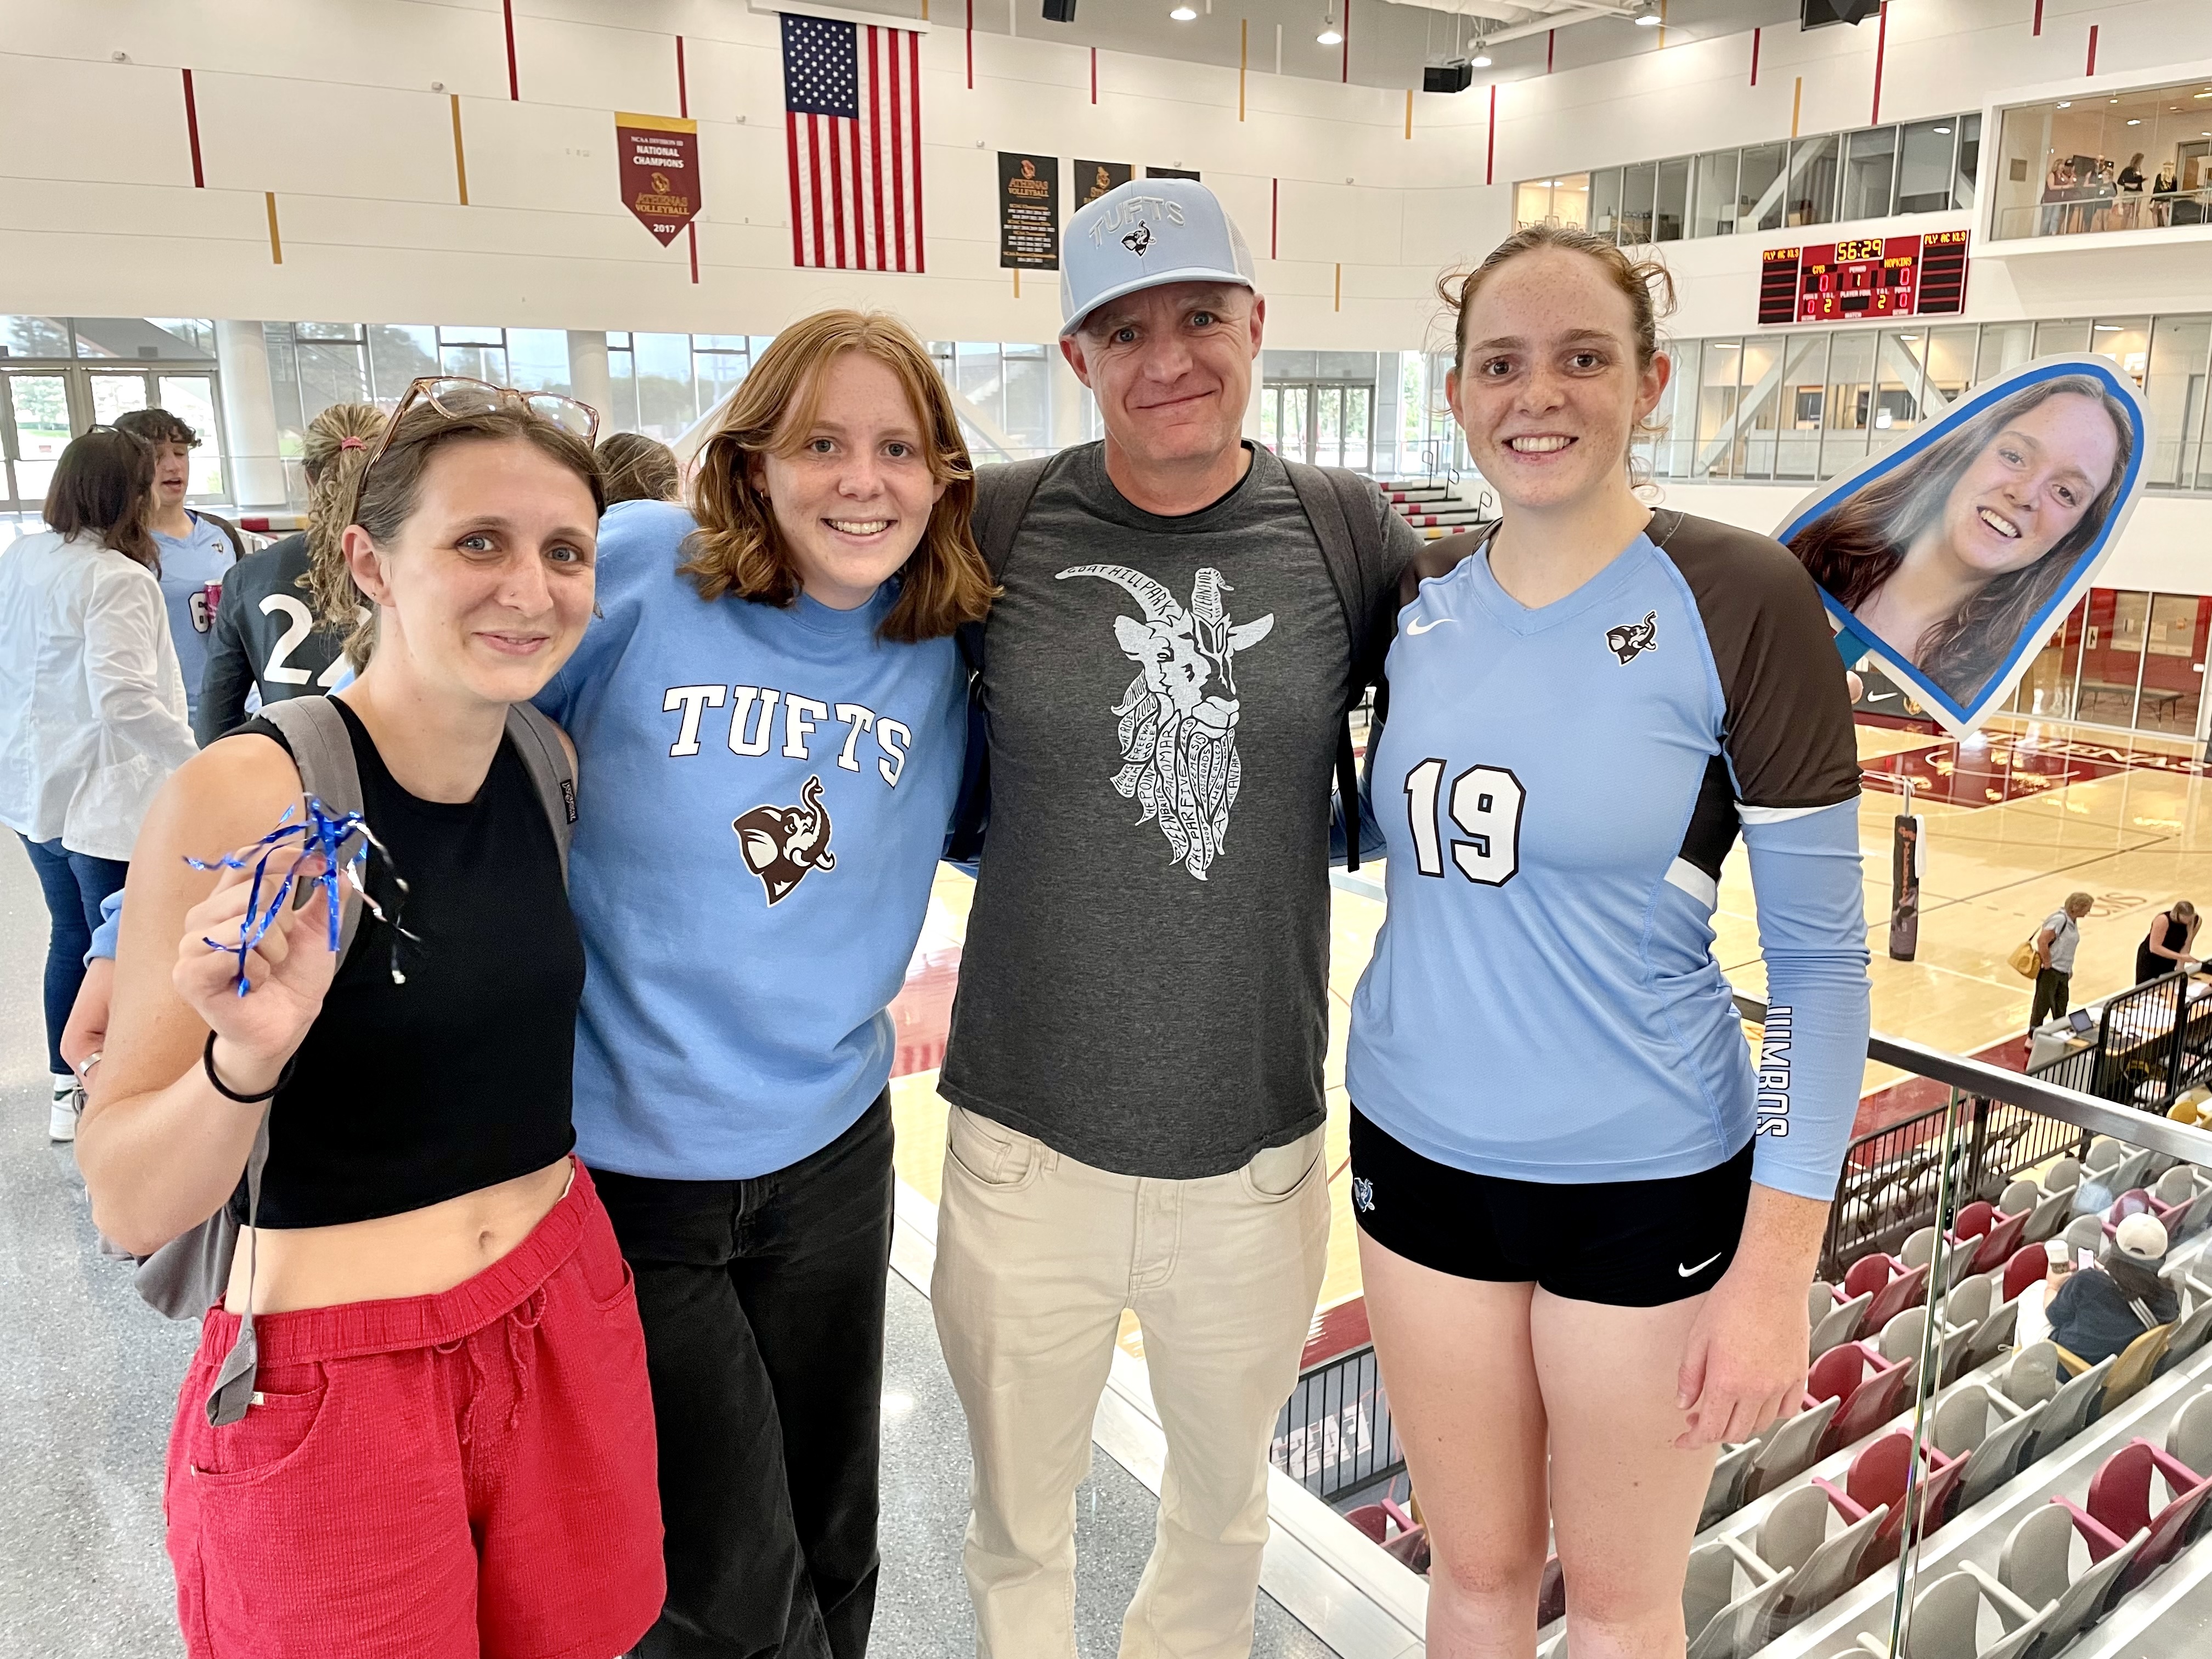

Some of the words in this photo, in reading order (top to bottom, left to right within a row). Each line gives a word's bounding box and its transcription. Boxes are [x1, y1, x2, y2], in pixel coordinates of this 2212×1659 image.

[633, 156, 685, 168] CHAMPIONS
[636, 145, 680, 157] NATIONAL
[1008, 188, 1049, 197] VOLLEYBALL
[635, 204, 690, 215] VOLLEYBALL
[653, 223, 675, 233] 2017
[1088, 196, 1185, 250] TUFTS
[1838, 239, 1882, 261] 56:29
[1819, 274, 1829, 292] 0
[1900, 267, 1910, 286] 0
[1807, 300, 1815, 313] 0
[1824, 298, 1832, 313] 2
[1878, 294, 1886, 309] 2
[1899, 292, 1908, 308] 0
[1108, 567, 1144, 588] HILL
[1138, 581, 1175, 616] PARK
[1120, 715, 1133, 733] RISE
[662, 684, 912, 790] TUFTS
[1127, 717, 1154, 760] FREEWAY
[1159, 723, 1177, 799] PALOMAR
[1189, 735, 1206, 793] NEMESIS
[1212, 744, 1221, 771] ALLEY
[1113, 765, 1134, 789] HAWKS
[1122, 766, 1142, 795] REALM
[1139, 765, 1155, 799] POINT
[1199, 748, 1210, 803] CROSSROADS
[1228, 754, 1239, 788] AVIARY
[1178, 759, 1194, 808] FIVE
[1210, 781, 1223, 809] THE
[1142, 802, 1155, 820] THE
[1403, 757, 1526, 888] 19
[1181, 811, 1200, 839] PAR
[1187, 847, 1201, 871] THE
[1204, 848, 1212, 867] THE
